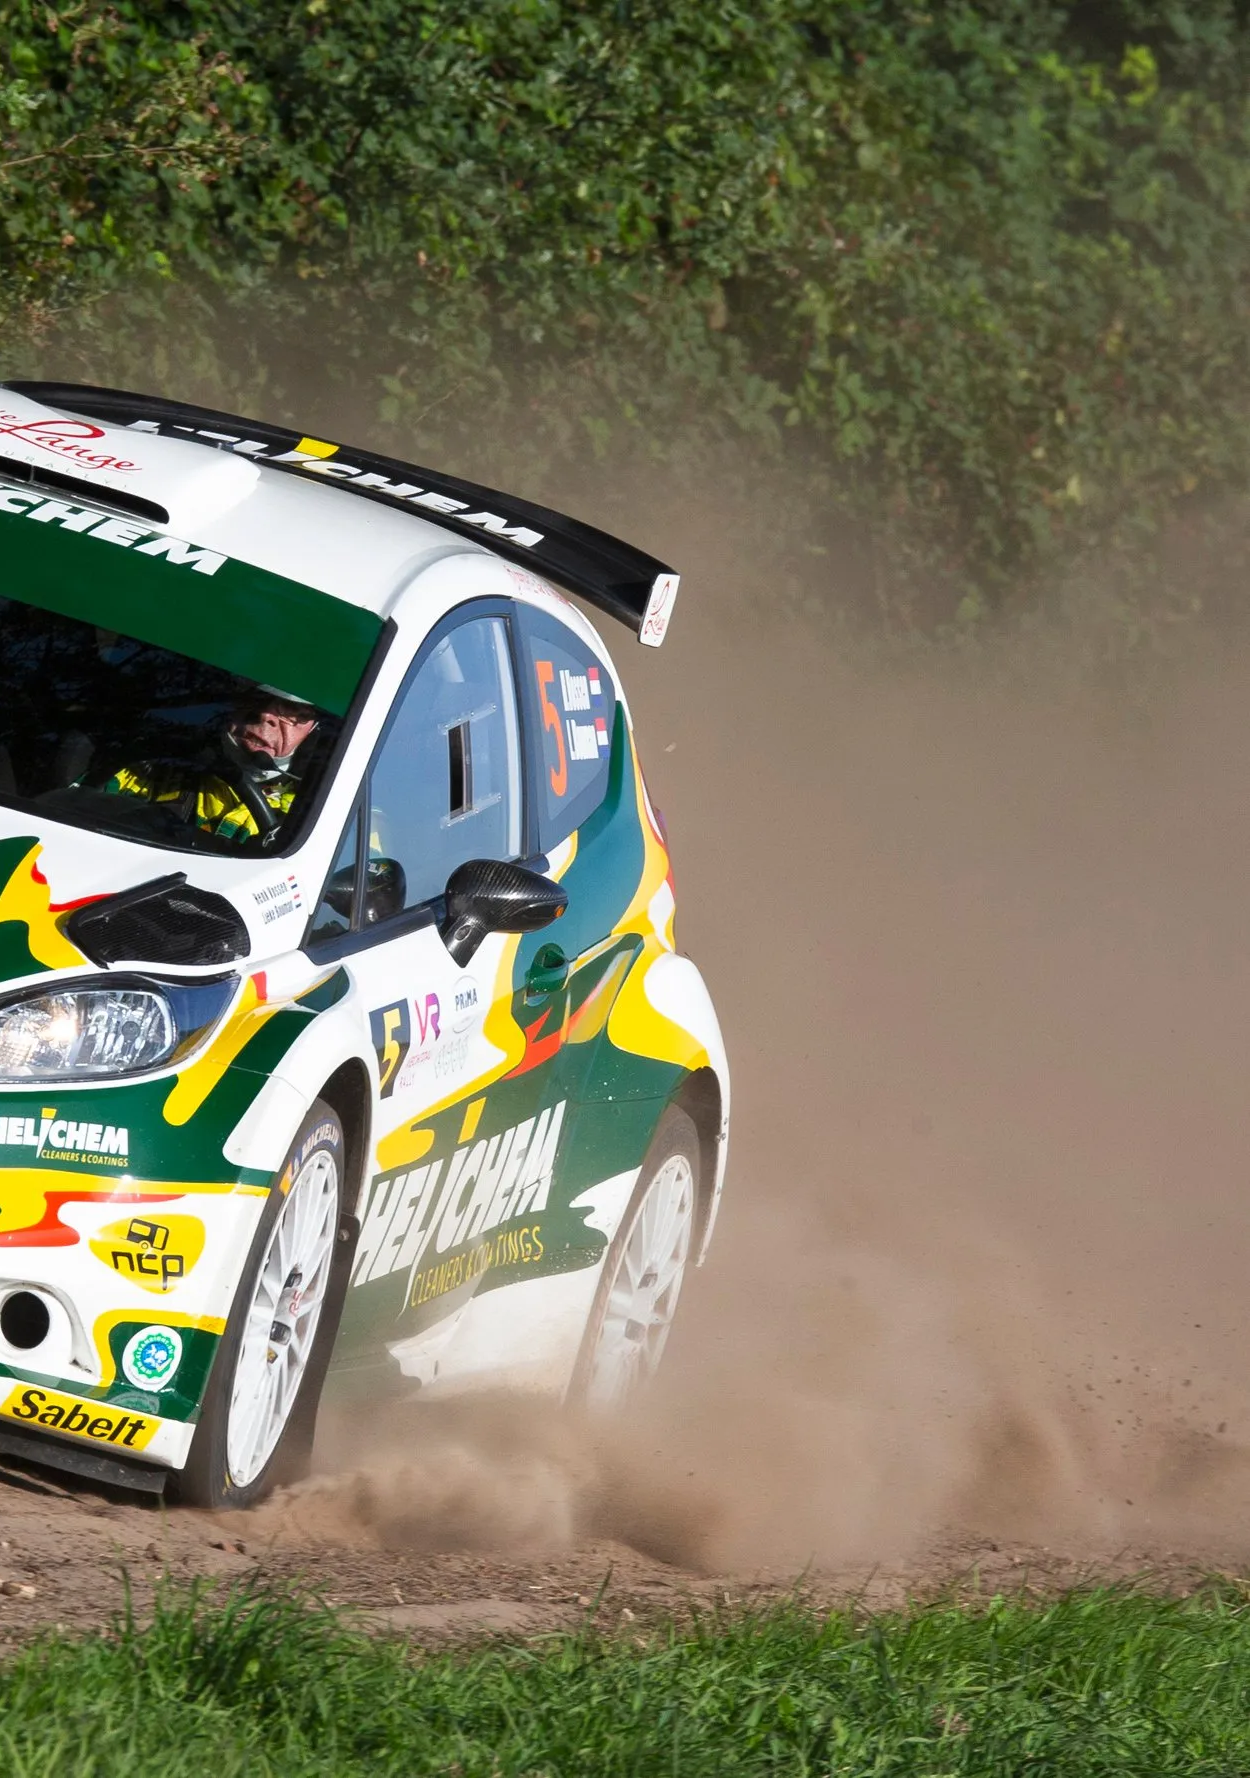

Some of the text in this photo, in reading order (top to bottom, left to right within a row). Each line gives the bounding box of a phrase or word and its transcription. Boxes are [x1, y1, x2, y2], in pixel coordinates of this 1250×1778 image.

[535, 660, 568, 797] 5
[414, 992, 441, 1047] VR
[379, 1007, 402, 1092] 5
[41, 1149, 79, 1162] CLEANERS
[87, 1154, 129, 1167] COATINGS
[111, 1250, 184, 1291] ncp
[410, 1252, 467, 1307] CLEANERS
[12, 1388, 147, 1447] Sabelt
